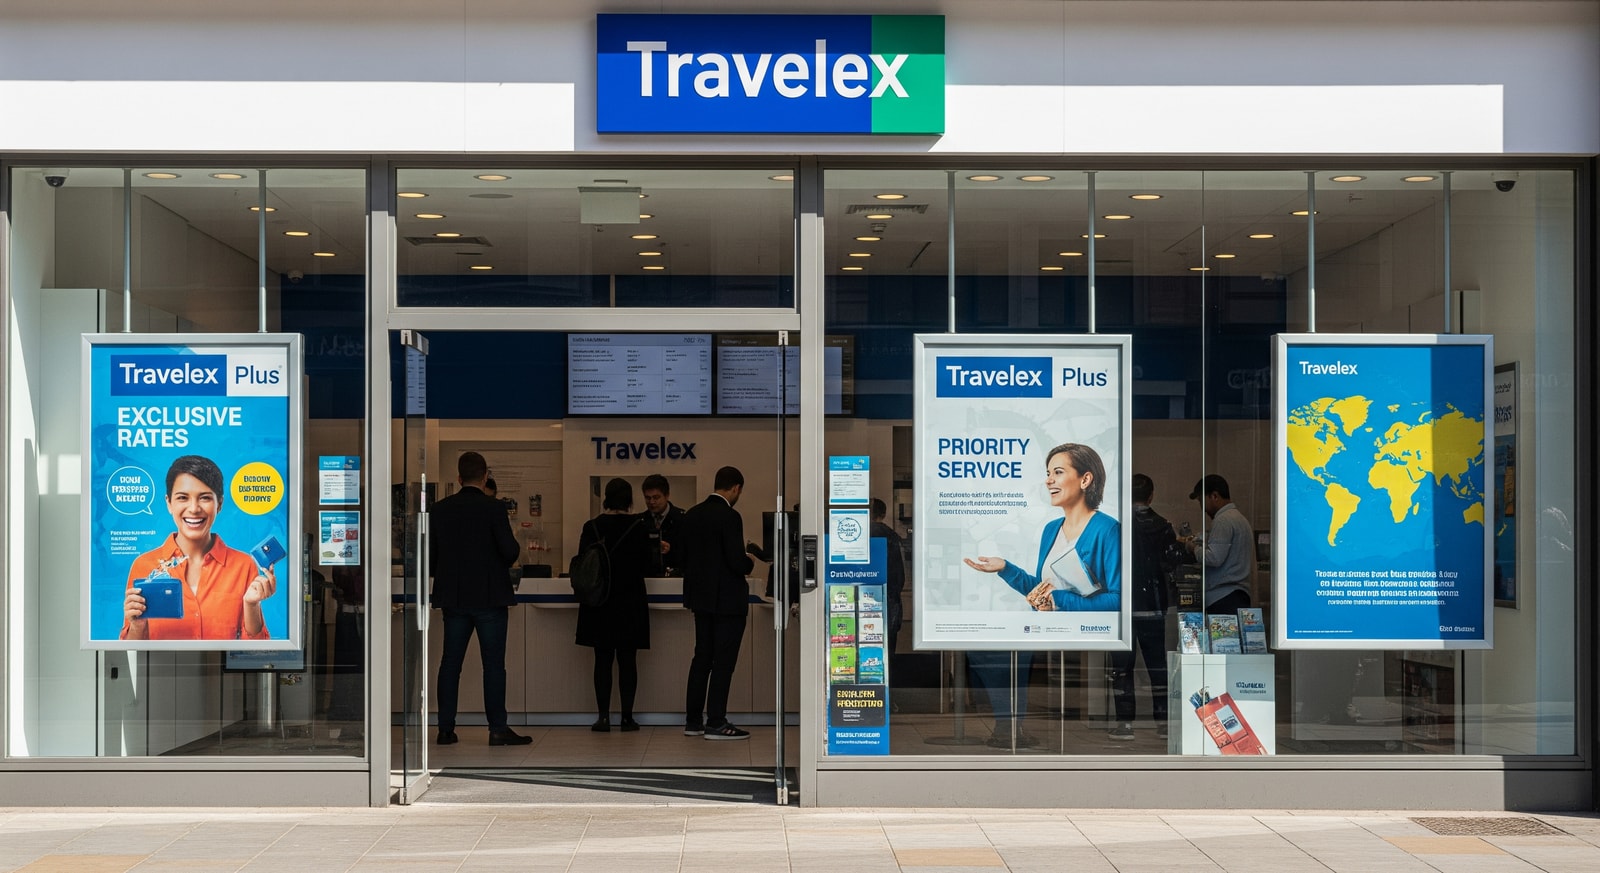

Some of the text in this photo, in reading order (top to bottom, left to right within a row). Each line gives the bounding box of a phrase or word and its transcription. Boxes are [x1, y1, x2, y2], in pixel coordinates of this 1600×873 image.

[627, 39, 910, 98] Travelex
[119, 362, 280, 385] Travelex Plus
[946, 365, 1107, 387] Travelex Plus
[1299, 361, 1358, 375] Travelex
[117, 407, 242, 427] EXCLUSIVE
[117, 429, 189, 448] RATES
[591, 436, 697, 461] Travelex
[938, 438, 1030, 456] PRIORITY
[938, 461, 1023, 479] SERVICE
